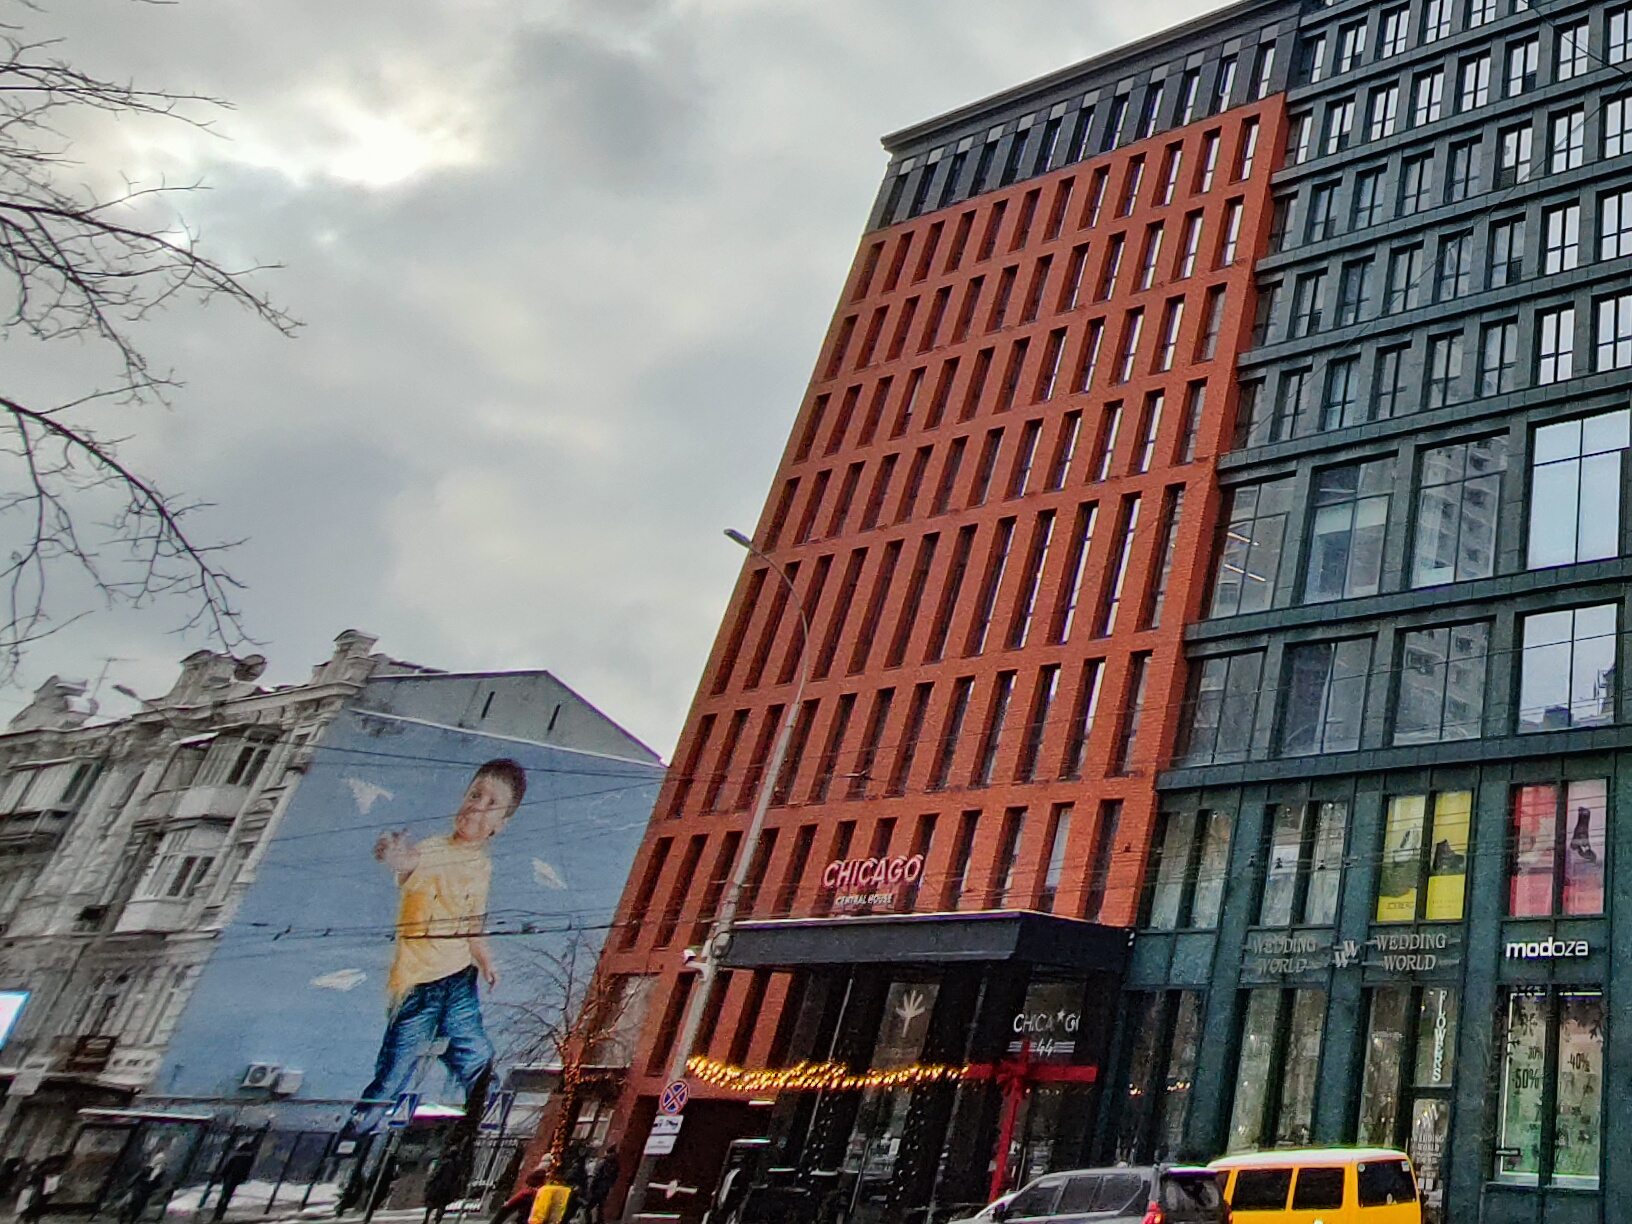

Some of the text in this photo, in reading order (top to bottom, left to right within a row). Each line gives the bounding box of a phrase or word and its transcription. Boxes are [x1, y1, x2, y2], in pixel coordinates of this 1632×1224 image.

[823, 854, 924, 887] CHICAGO
[868, 893, 893, 905] HOUSE
[1253, 937, 1316, 954] WEDDING
[1376, 933, 1447, 951] WEDDING
[1506, 936, 1589, 958] modoza
[1259, 958, 1308, 975] WORLD
[1383, 955, 1437, 971] WORLD
[1433, 990, 1447, 1082] FLOWERS
[1036, 1038, 1053, 1057] 44
[1512, 1068, 1540, 1089] -50%
